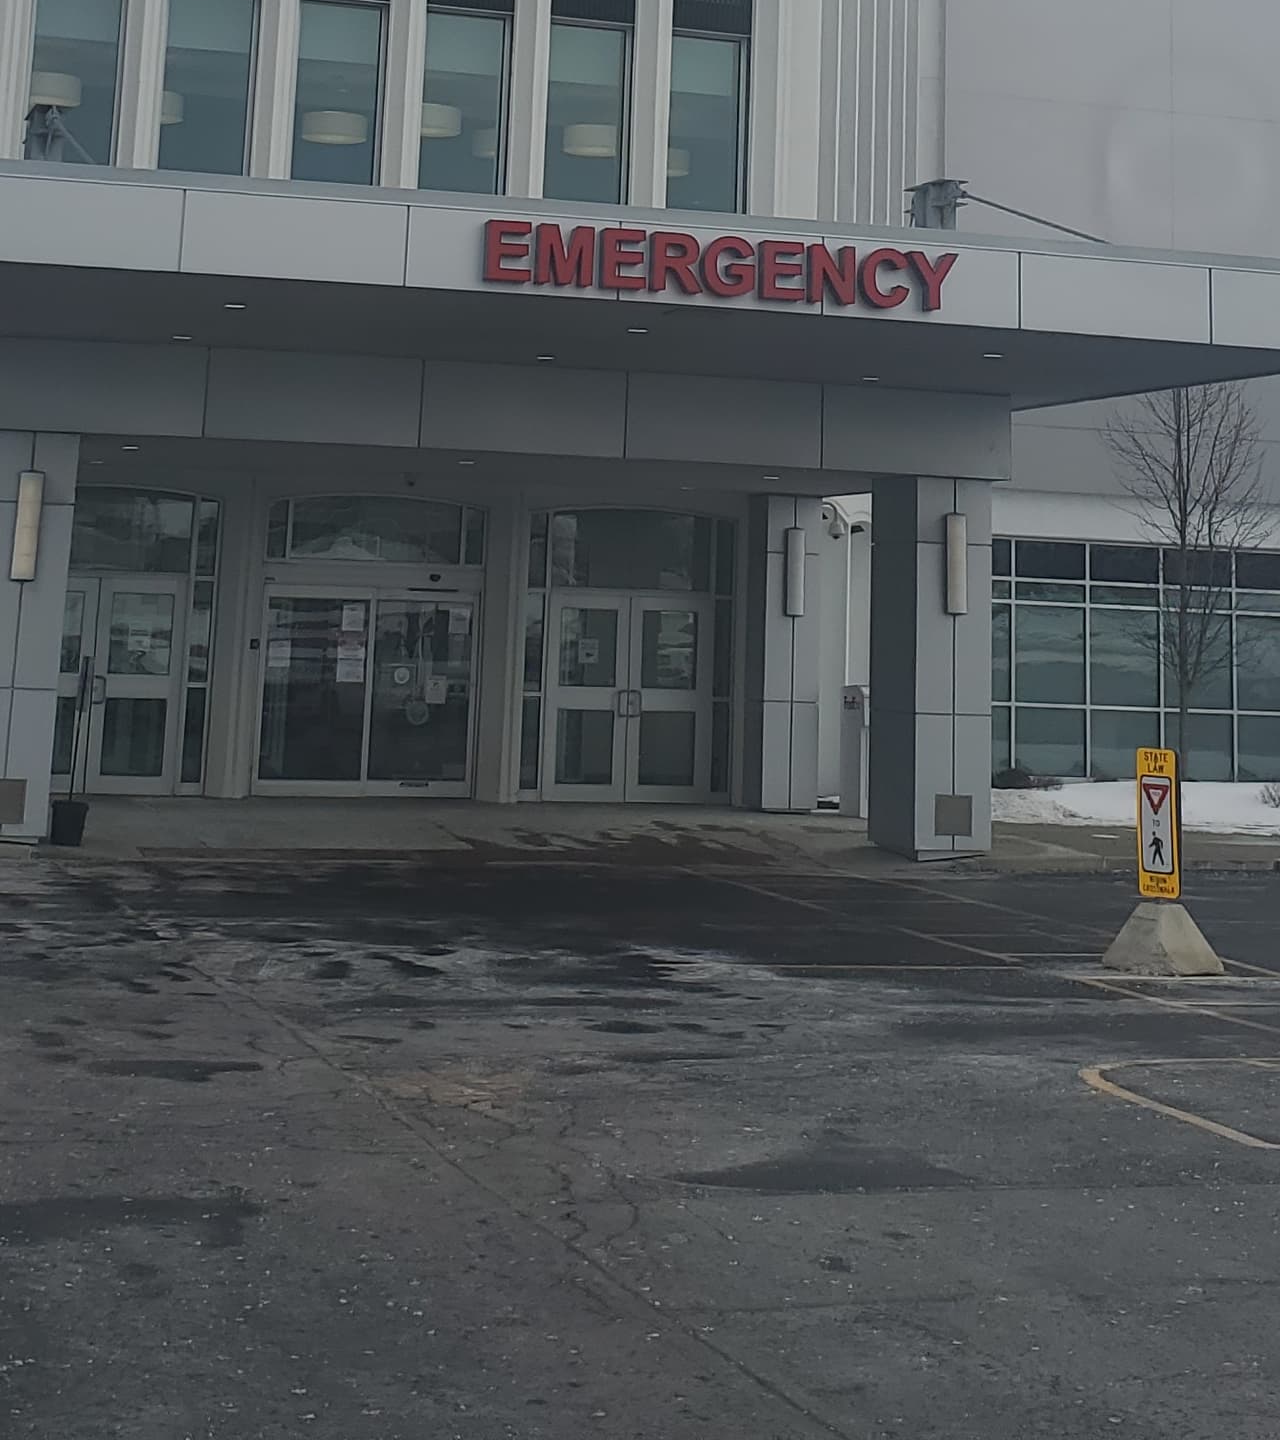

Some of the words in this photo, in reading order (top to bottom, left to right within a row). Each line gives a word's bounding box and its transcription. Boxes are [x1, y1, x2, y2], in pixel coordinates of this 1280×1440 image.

[482, 219, 959, 312] EMERGENCY
[1143, 751, 1169, 763] STATE
[1147, 763, 1164, 774] LAW
